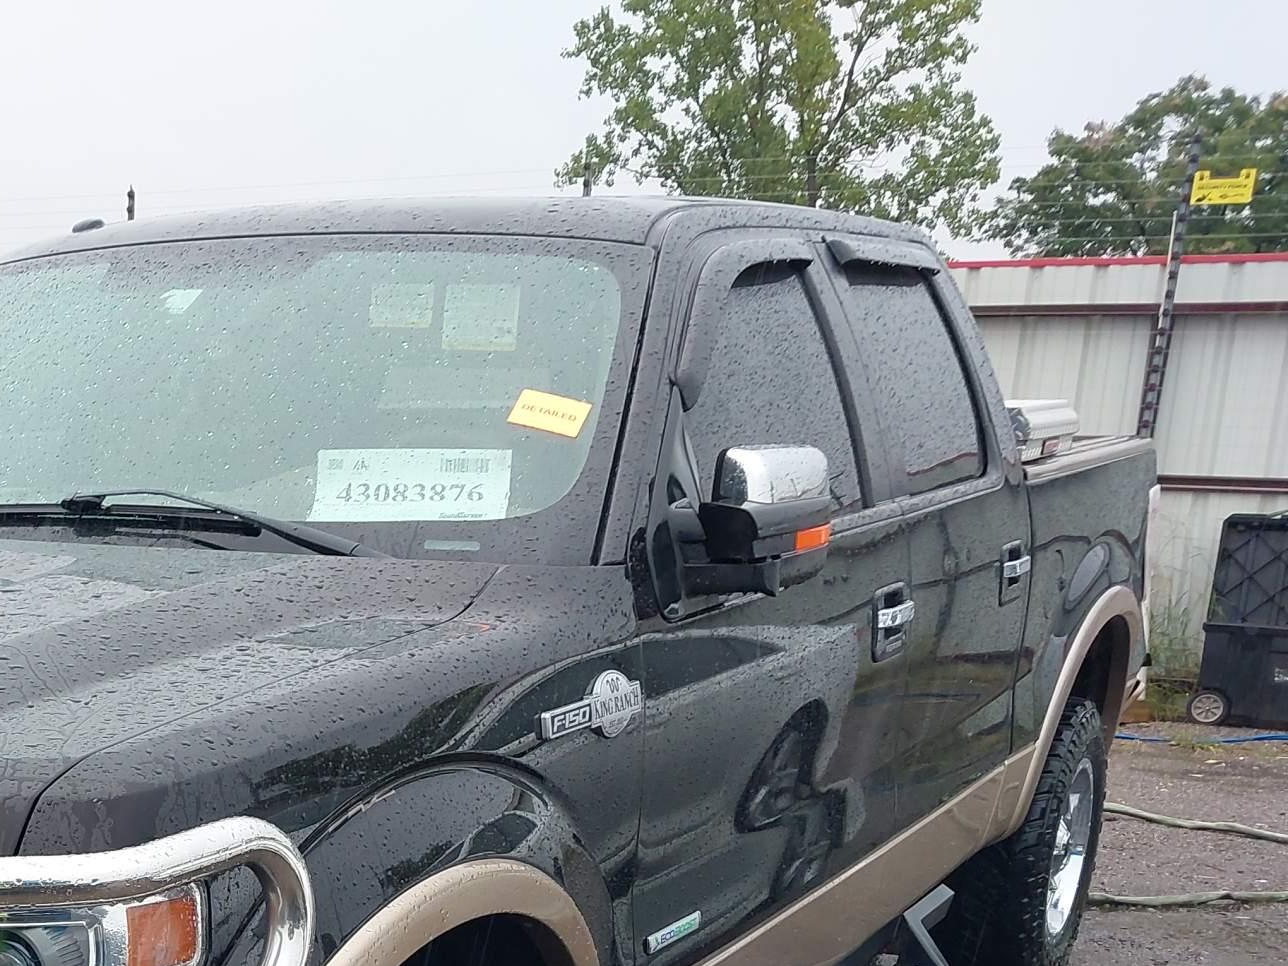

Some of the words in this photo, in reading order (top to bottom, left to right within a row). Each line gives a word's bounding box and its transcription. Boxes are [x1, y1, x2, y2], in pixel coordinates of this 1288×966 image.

[521, 403, 578, 422] DETAILED
[335, 482, 485, 503] 43083876
[593, 696, 614, 721] KING
[614, 686, 640, 714] RANCH
[553, 705, 591, 733] F-150
